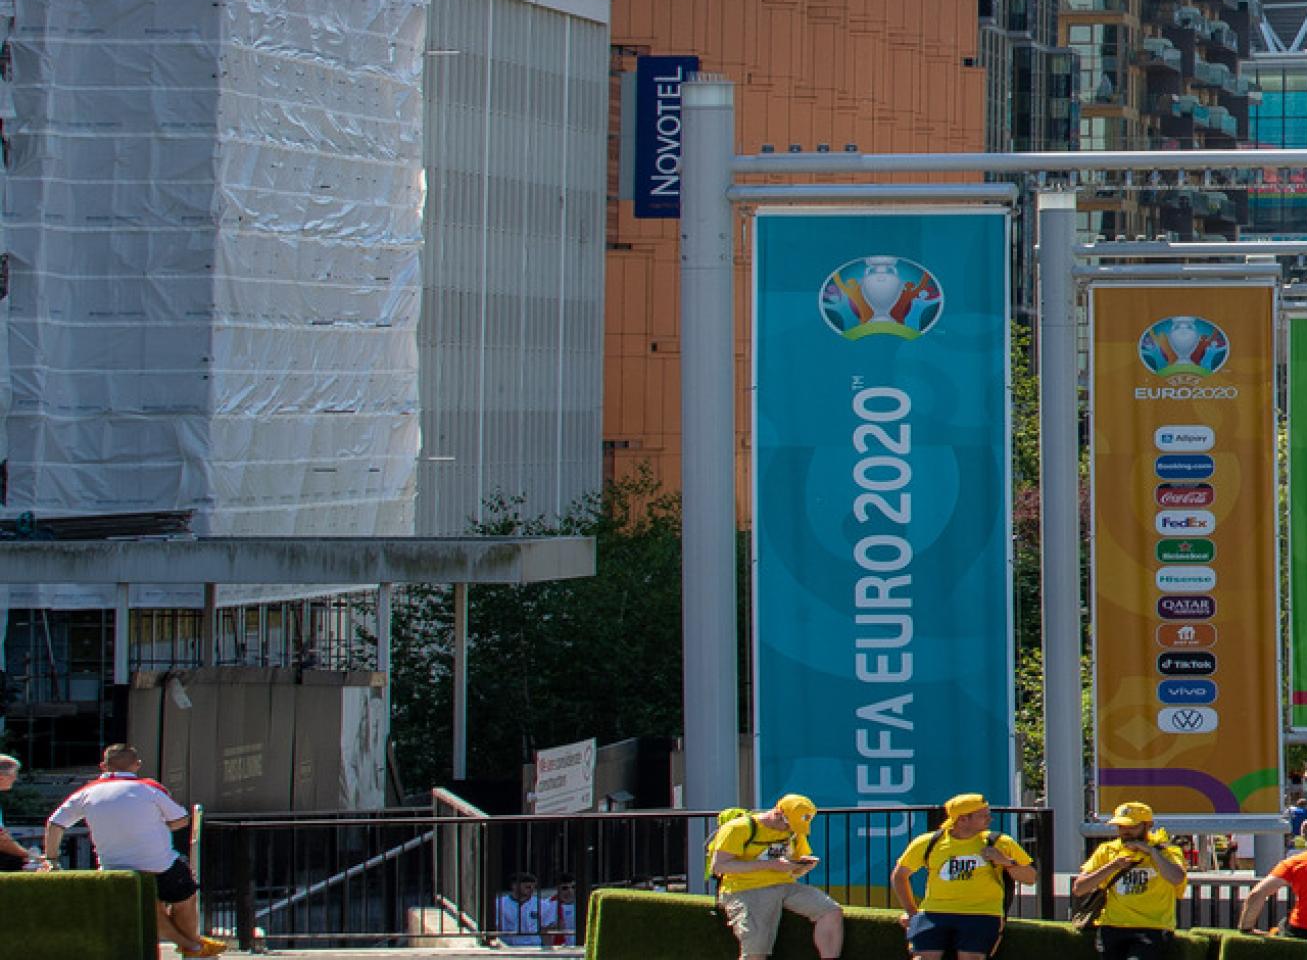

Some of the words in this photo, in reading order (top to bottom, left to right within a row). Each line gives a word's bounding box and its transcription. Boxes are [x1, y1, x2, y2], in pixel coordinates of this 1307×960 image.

[651, 65, 683, 196] NOVOTEL
[1161, 513, 1208, 528] FedEx
[853, 534, 914, 683] EURO
[1162, 600, 1210, 610] QATAR
[855, 692, 915, 837] UEFA
